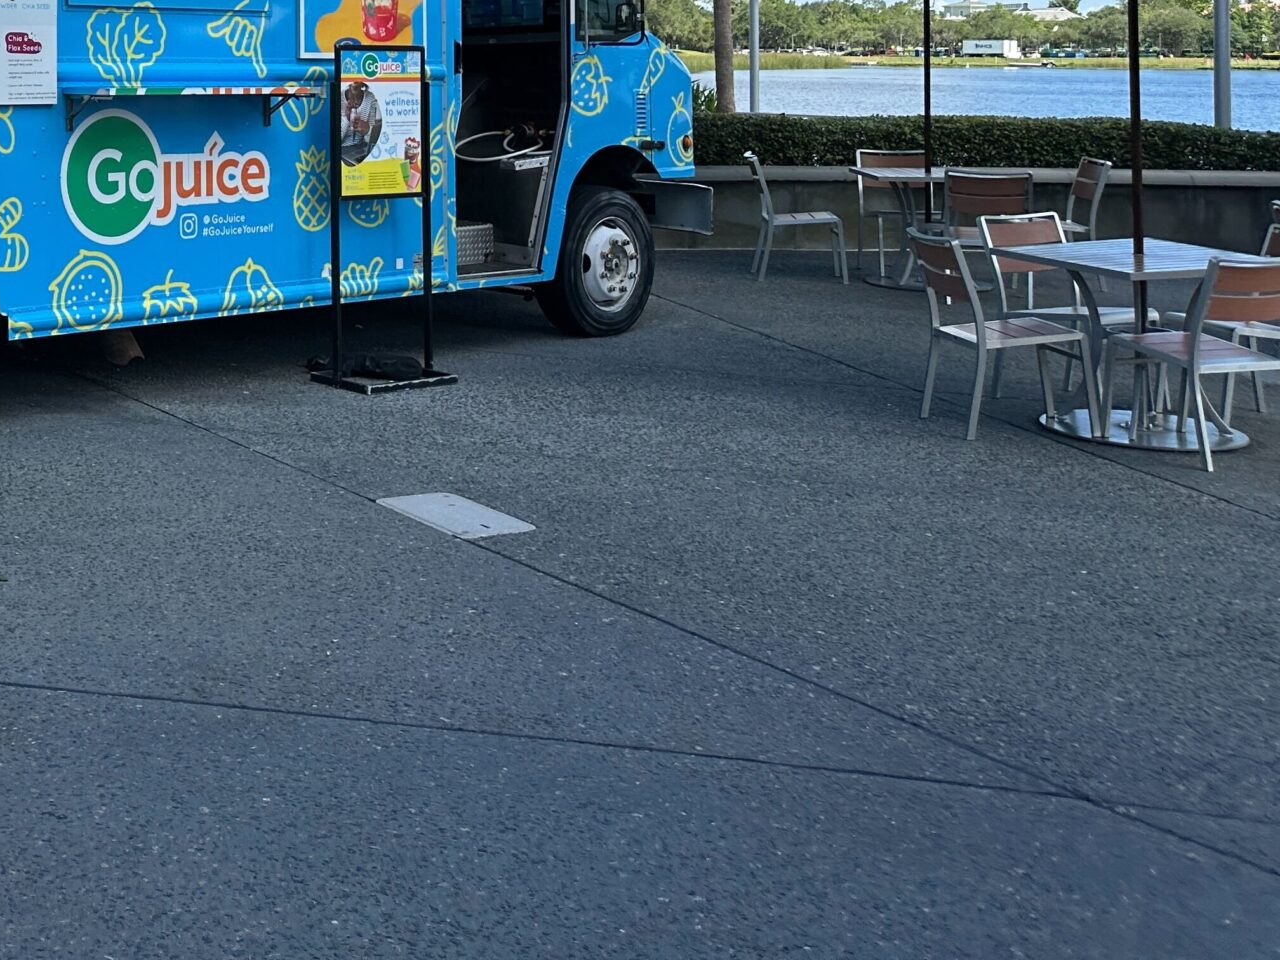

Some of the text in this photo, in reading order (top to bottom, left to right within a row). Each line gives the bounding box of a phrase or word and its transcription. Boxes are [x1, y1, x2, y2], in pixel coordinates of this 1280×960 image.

[7, 34, 22, 42] Chia
[385, 97, 419, 106] wellness
[385, 107, 419, 117] to work!
[202, 224, 274, 238] #GoJuiceYourself
